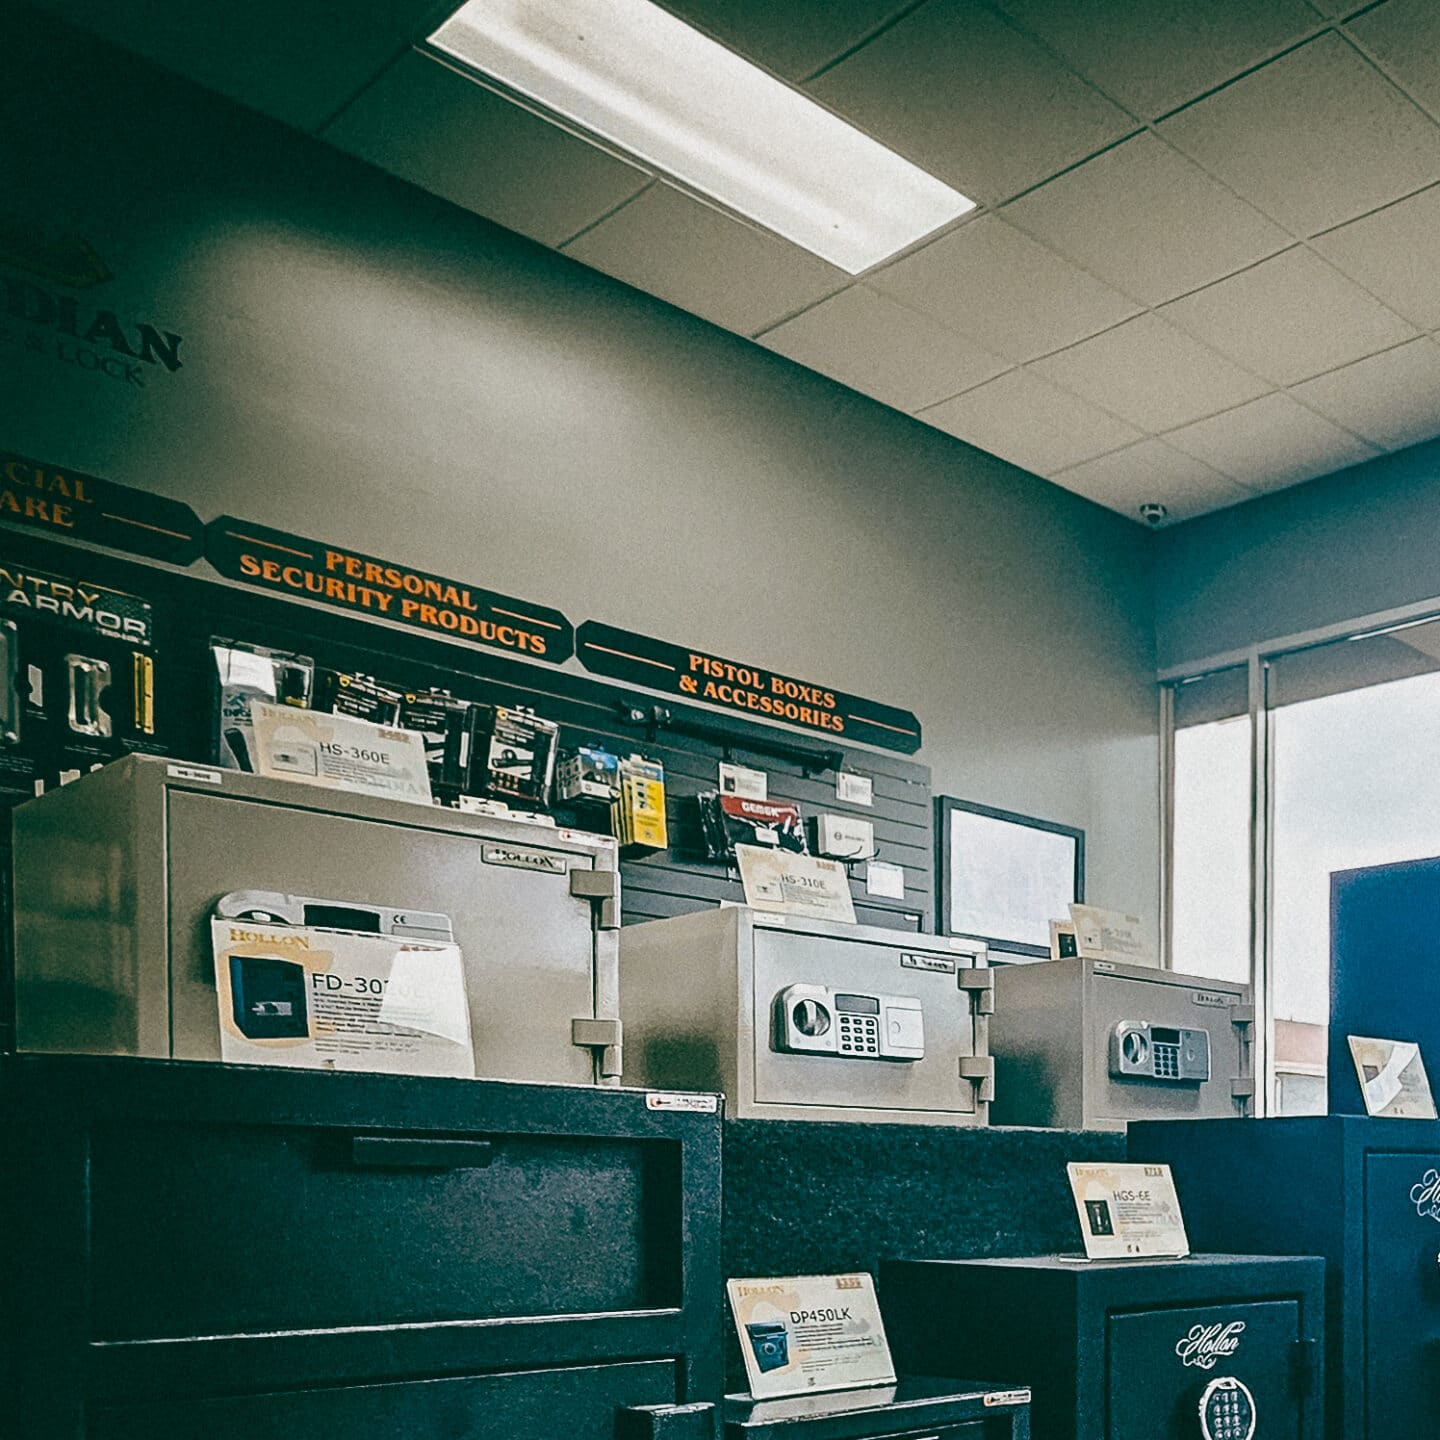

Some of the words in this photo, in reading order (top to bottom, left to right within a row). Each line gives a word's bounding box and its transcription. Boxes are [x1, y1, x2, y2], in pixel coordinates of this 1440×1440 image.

[57, 340, 145, 388] LOCK
[239, 554, 393, 612] SECURITY
[399, 598, 547, 655] PRODUCTS
[325, 550, 479, 612] PERSONAL
[7, 589, 147, 636] ARMOR
[678, 674, 698, 694] &
[703, 681, 846, 733] ACCESSORIES
[688, 653, 765, 690] PISTOL
[770, 675, 837, 710] BOXES
[319, 741, 390, 765] HS-360E
[229, 927, 310, 949] HOLLON
[311, 972, 389, 995] FD-30
[789, 1306, 853, 1324] DP450LK
[1175, 1321, 1247, 1369] Hollon
